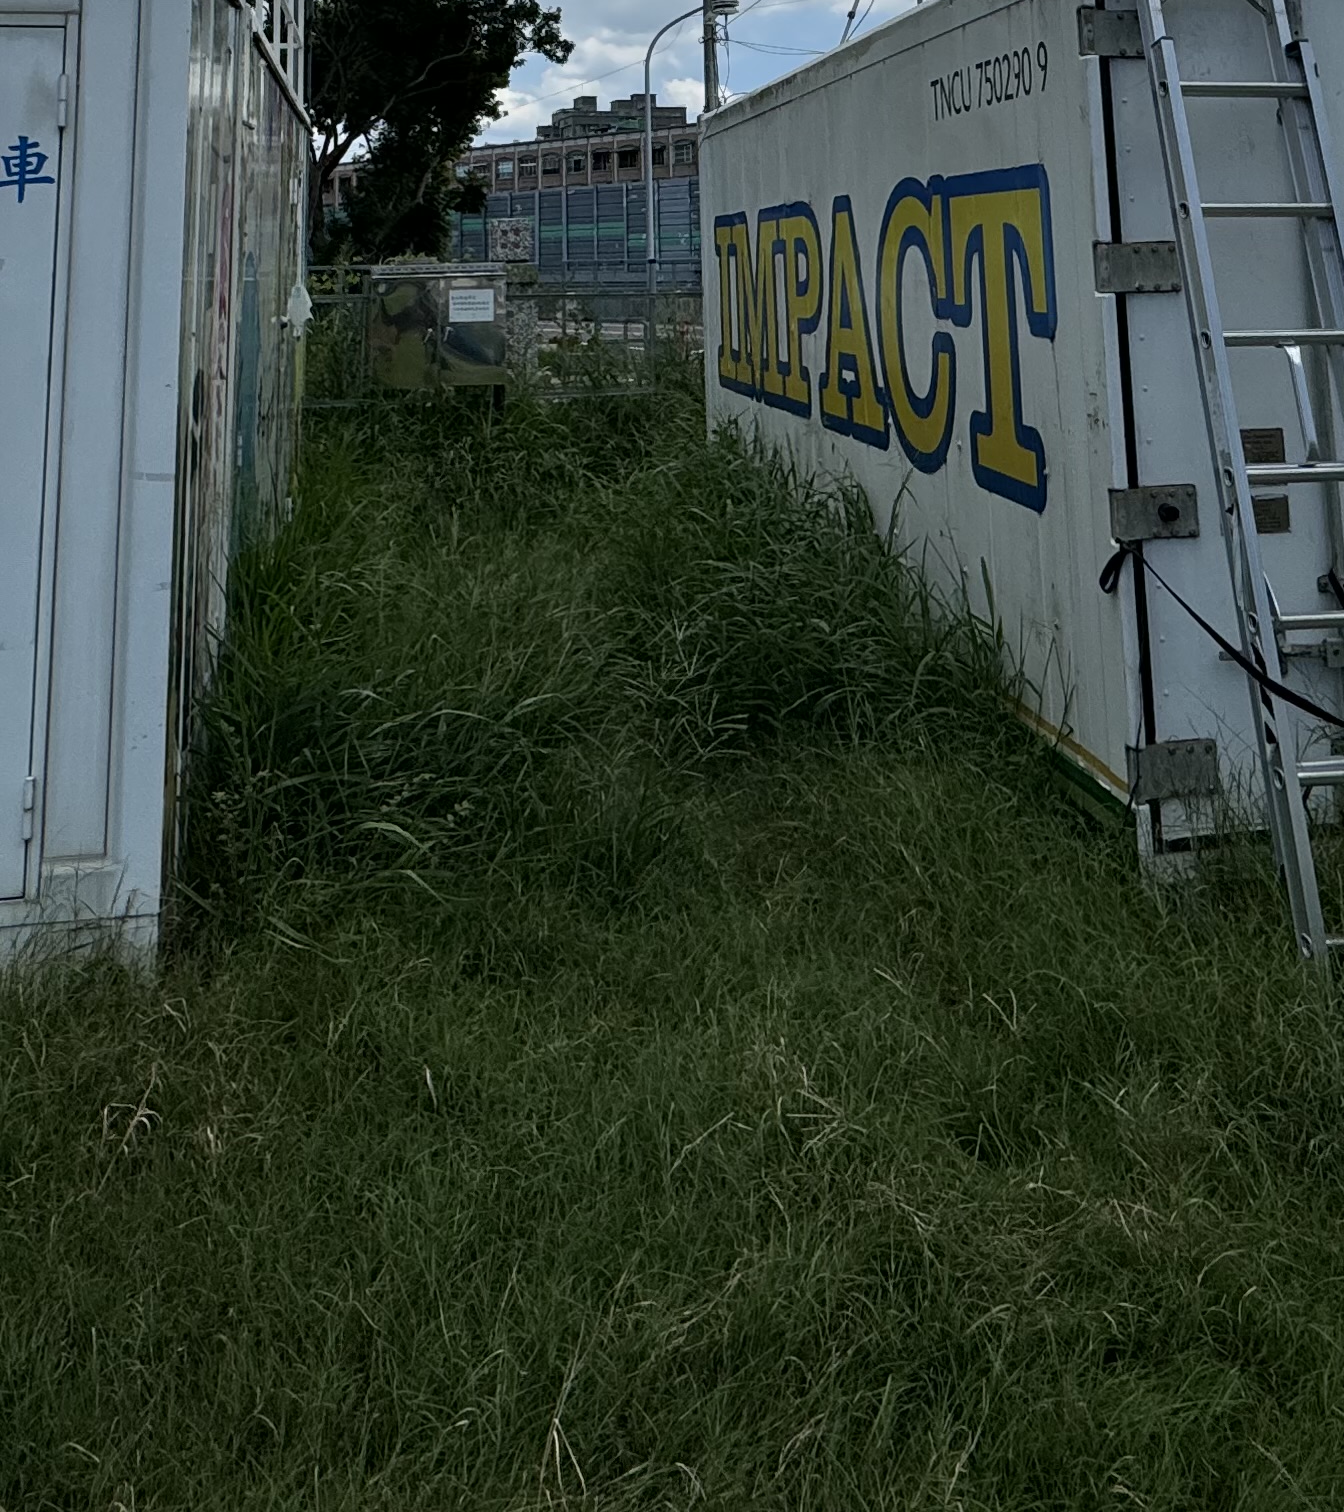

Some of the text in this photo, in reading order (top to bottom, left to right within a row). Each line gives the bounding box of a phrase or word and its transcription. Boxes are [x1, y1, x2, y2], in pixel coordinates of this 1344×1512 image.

[929, 40, 1048, 122] TNCU 750290 9
[714, 164, 1056, 515] IMPACT
